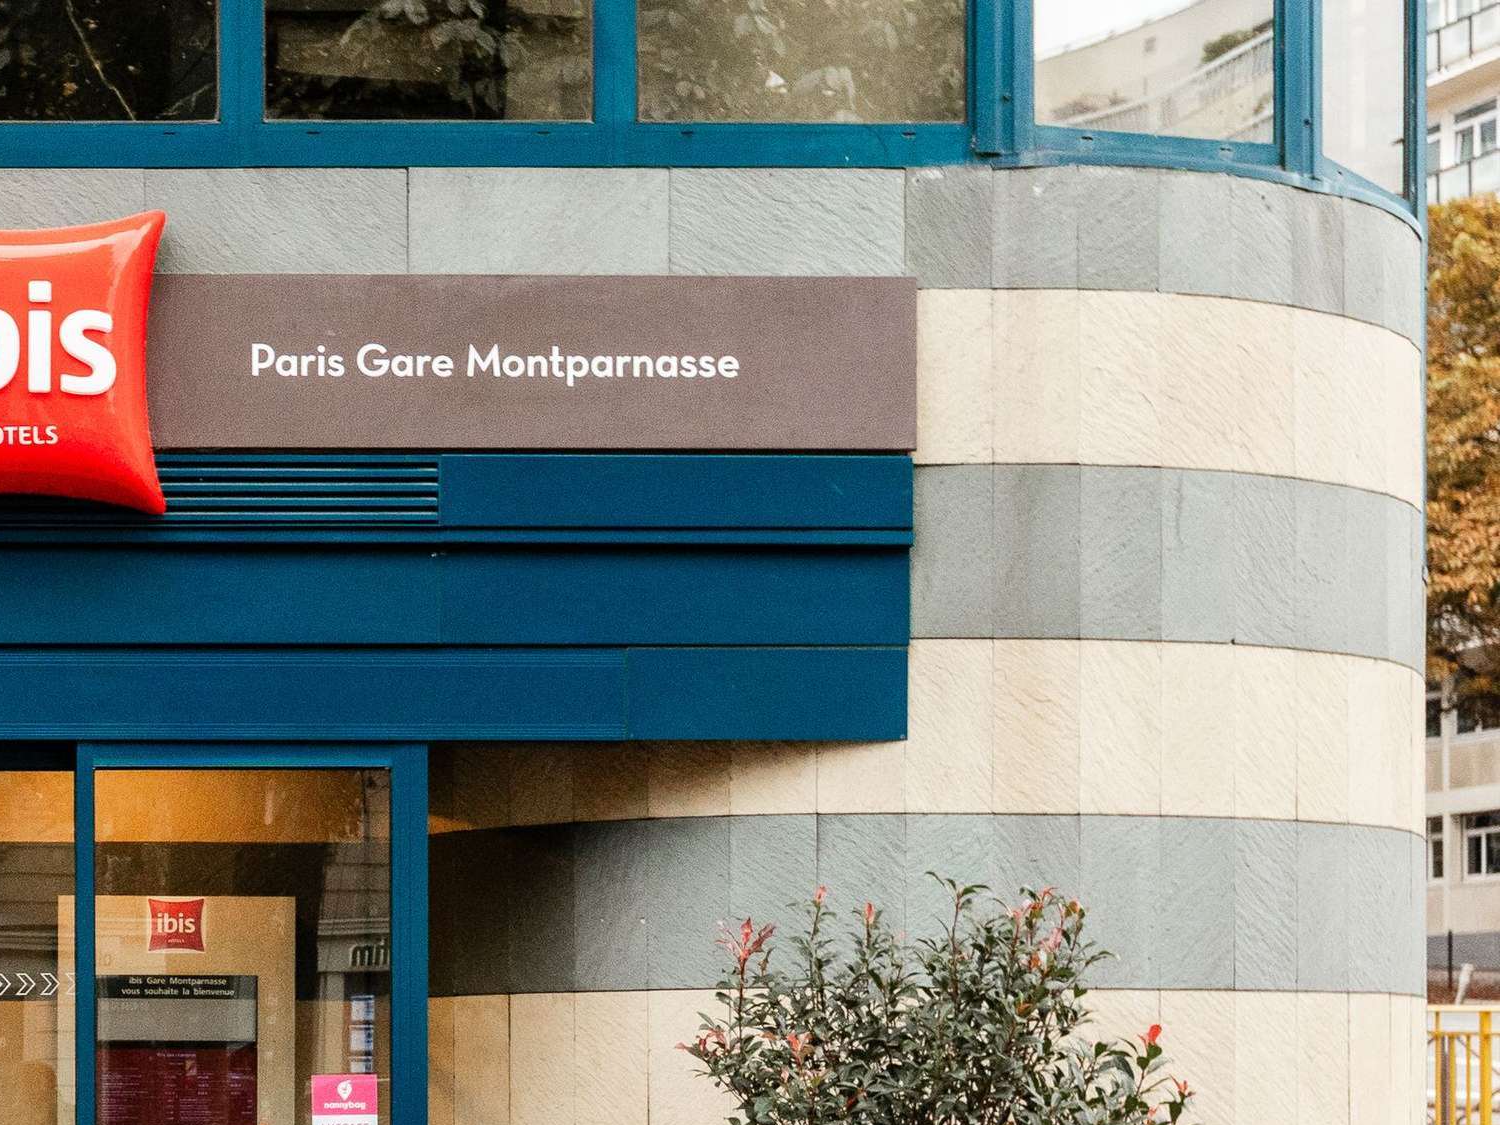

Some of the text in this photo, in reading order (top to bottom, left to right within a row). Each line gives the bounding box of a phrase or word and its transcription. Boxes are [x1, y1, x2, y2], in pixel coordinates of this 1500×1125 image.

[251, 343, 741, 388] Paris Gare Montparnasse
[157, 912, 196, 934] ibis
[128, 977, 227, 986] ibis Gare Montparnasse
[144, 987, 179, 995] souhaite
[183, 987, 190, 995] la
[193, 988, 235, 996] bienvenue
[323, 1101, 367, 1111] nannybag
